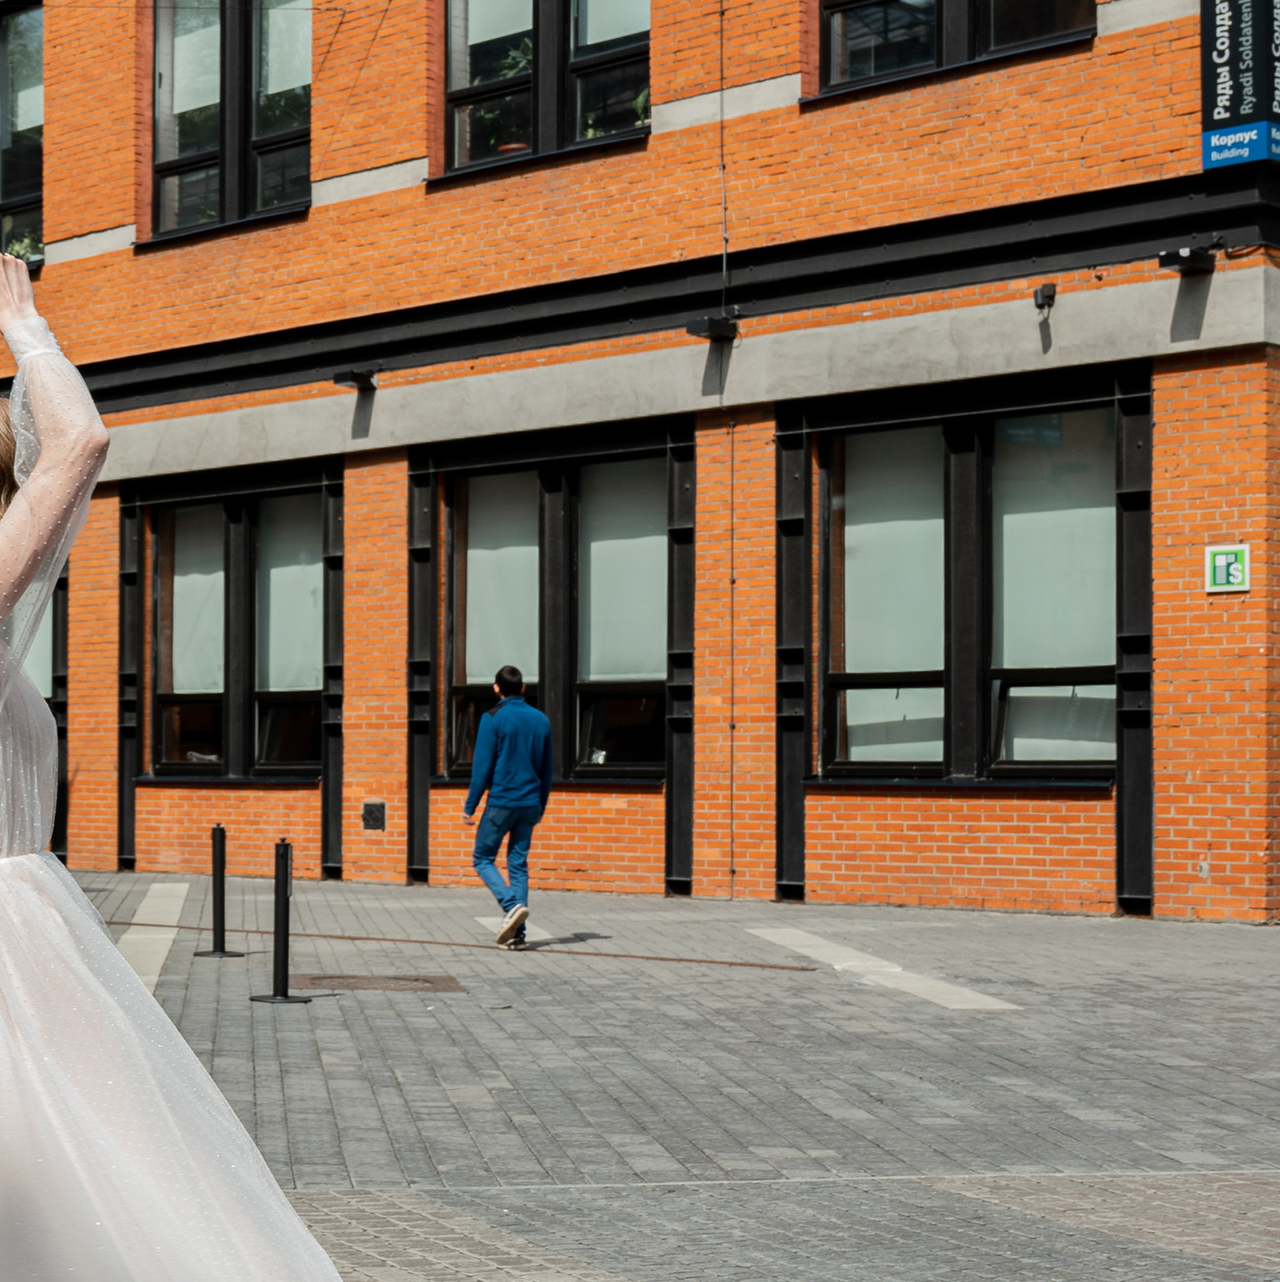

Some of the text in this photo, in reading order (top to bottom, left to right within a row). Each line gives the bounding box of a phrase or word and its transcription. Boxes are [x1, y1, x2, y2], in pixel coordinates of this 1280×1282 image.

[1213, 66, 1233, 120] Ряды
[1239, 71, 1256, 115] Ryadi
[1211, 130, 1258, 147] Корпус
[1211, 147, 1249, 161] Building
